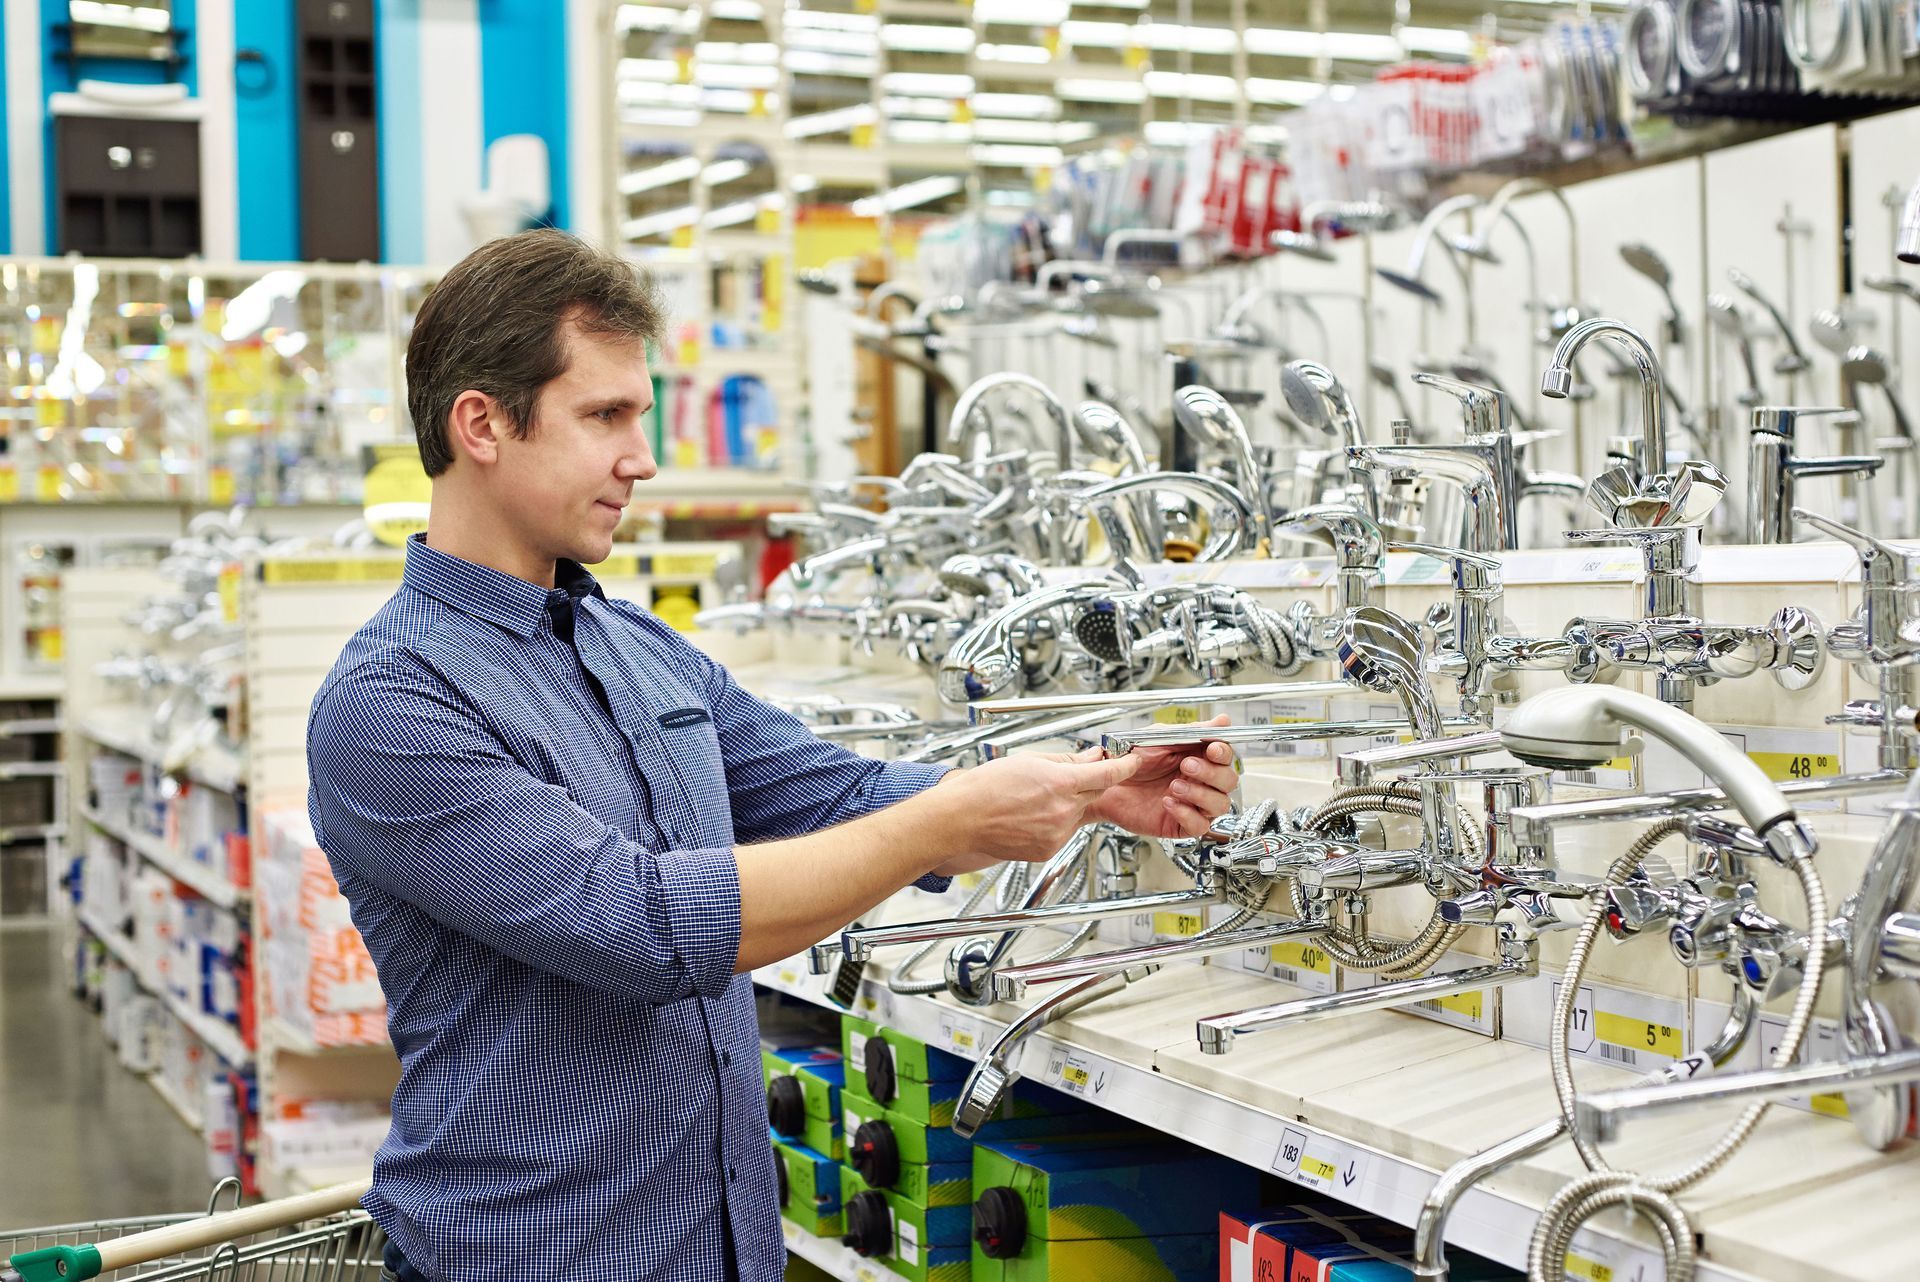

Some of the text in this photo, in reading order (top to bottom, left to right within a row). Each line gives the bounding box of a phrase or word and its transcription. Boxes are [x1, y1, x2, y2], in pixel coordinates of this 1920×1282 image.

[1790, 757, 1827, 778] 48 00
[1301, 947, 1324, 968] 40 00
[1568, 1007, 1588, 1031] 17
[1647, 1024, 1671, 1046] 5 00
[1282, 1144, 1299, 1162] 183
[1317, 1163, 1328, 1176] 77
